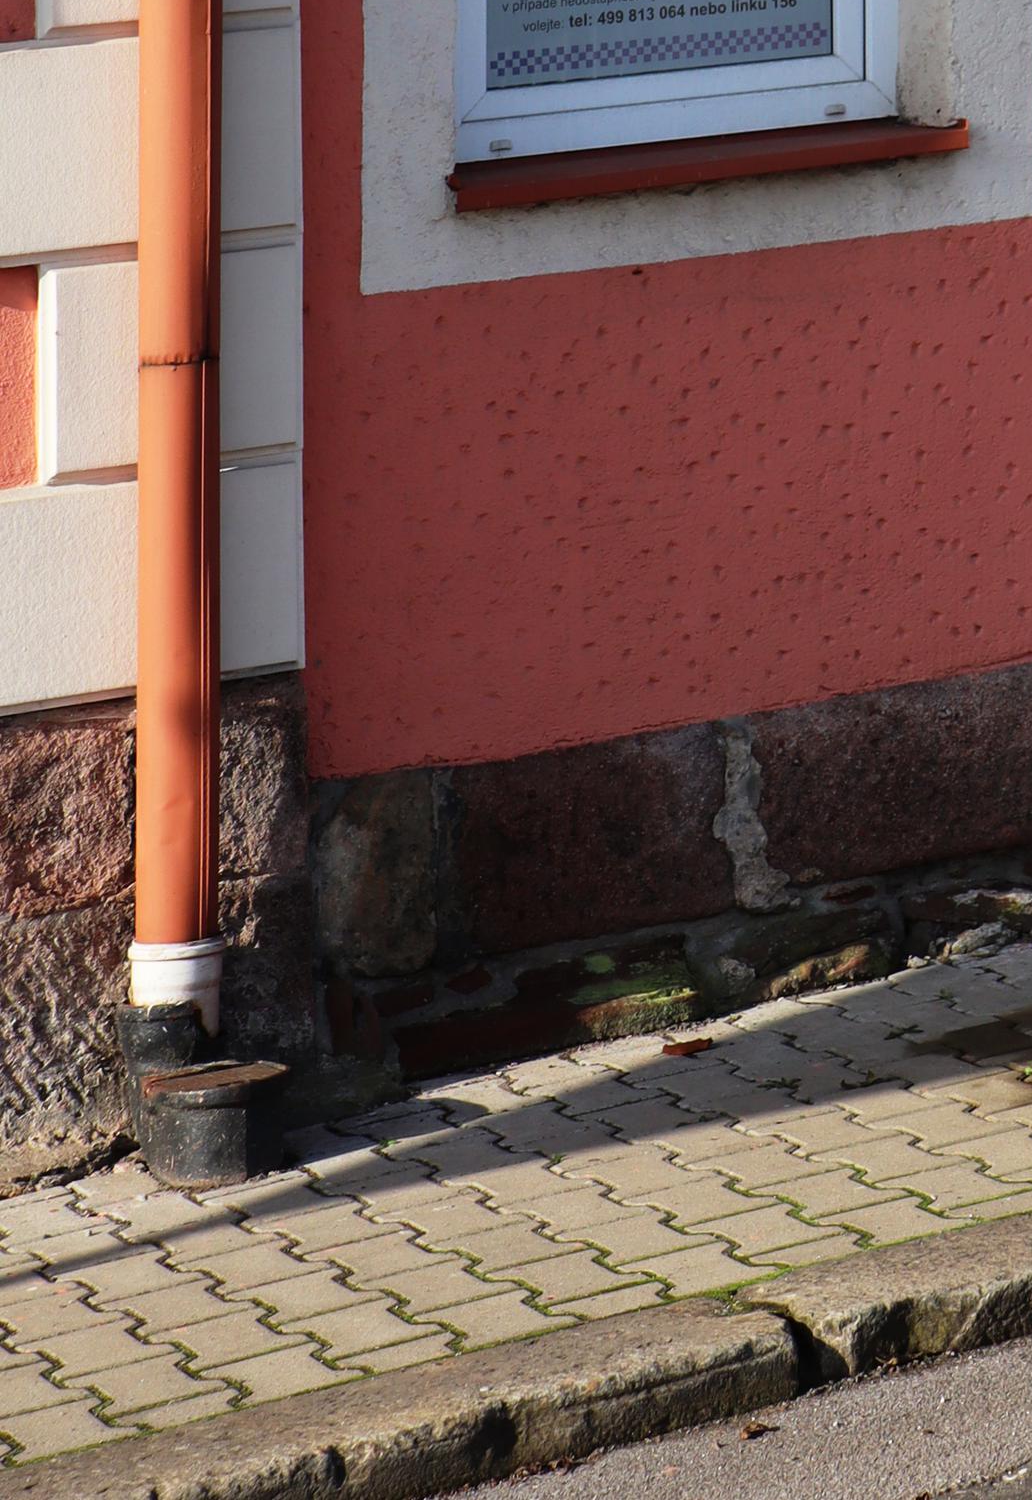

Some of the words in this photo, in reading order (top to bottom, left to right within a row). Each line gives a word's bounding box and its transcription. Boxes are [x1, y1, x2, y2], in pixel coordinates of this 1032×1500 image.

[502, 4, 509, 12] v
[569, 13, 593, 28] tel:
[597, 10, 624, 25] 499
[628, 7, 655, 22] 813
[659, 4, 686, 19] 064
[690, 2, 727, 16] nebo
